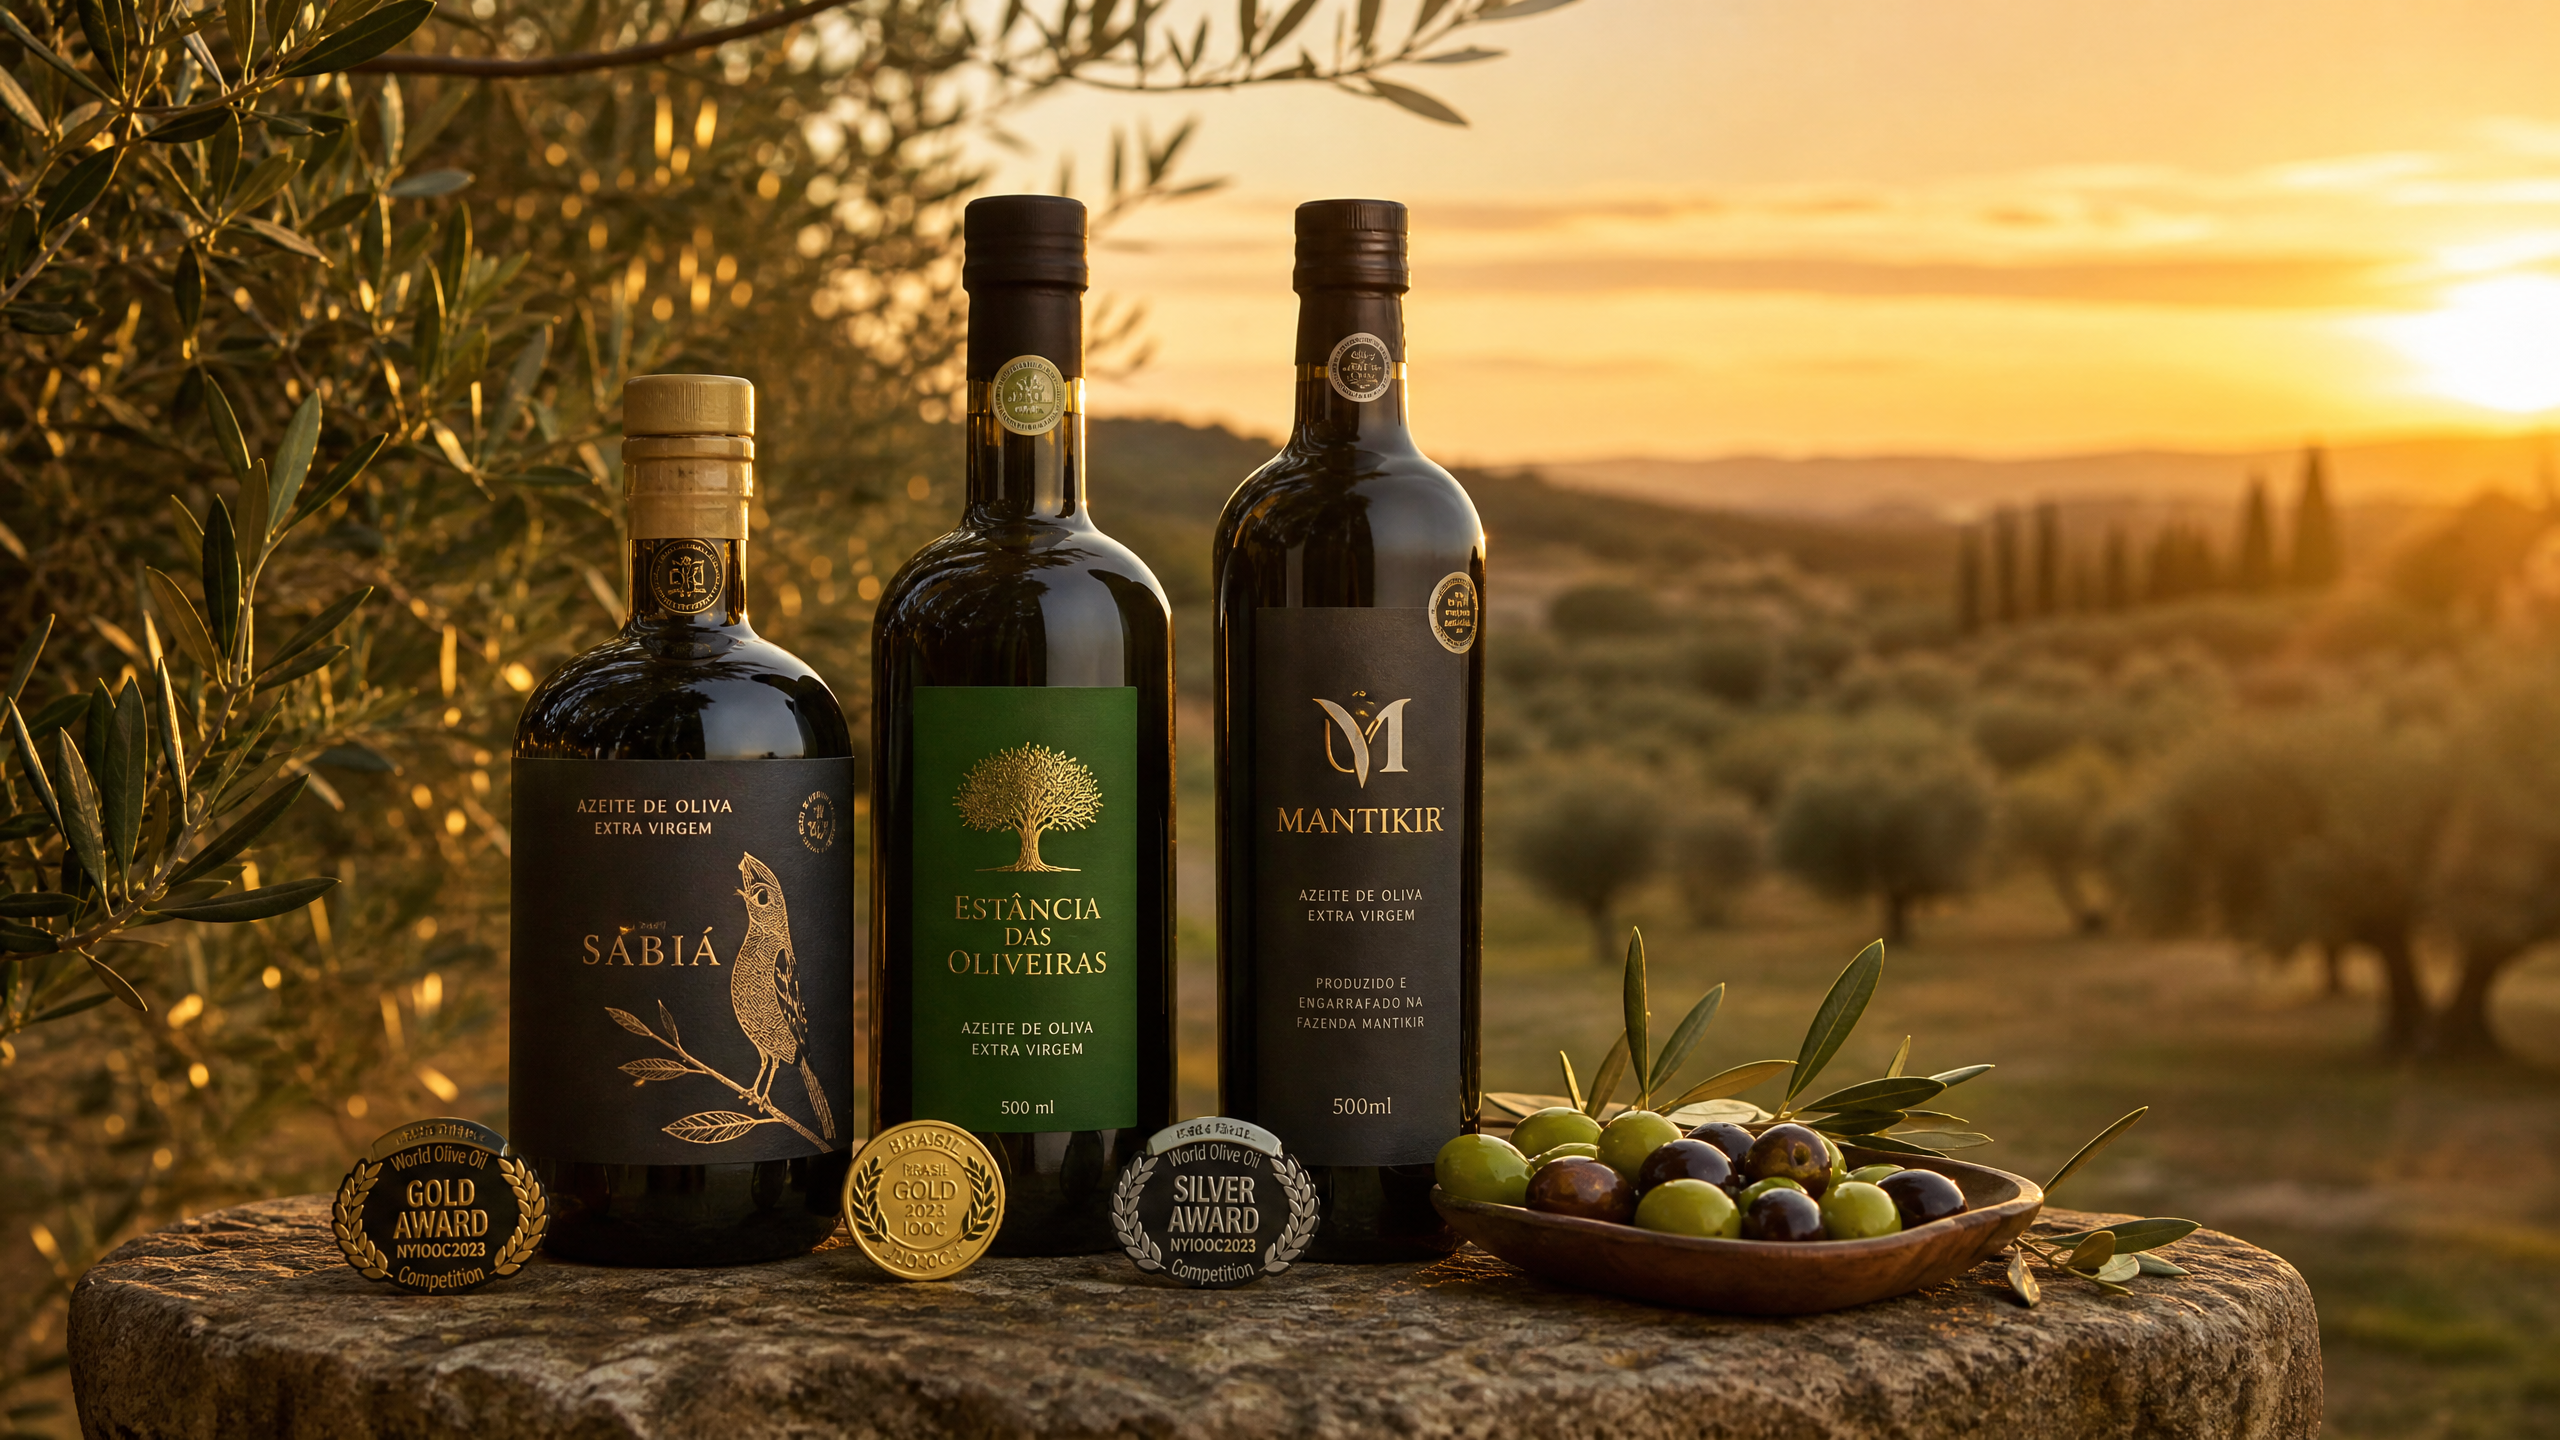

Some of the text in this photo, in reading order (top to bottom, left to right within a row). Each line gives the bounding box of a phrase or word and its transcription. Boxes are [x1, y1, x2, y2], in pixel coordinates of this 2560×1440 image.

[577, 799, 732, 813] AZEITE DE OLIVA
[595, 822, 711, 834] EXTRA VIRGEM
[1277, 807, 1444, 833] MANTIKIR
[1299, 889, 1422, 901] AZEITE DE OLIVA
[955, 893, 1101, 920] ESTÂNCIA
[1309, 909, 1414, 921] EXTRA VIRGEM
[1006, 928, 1050, 946] DAS
[948, 951, 1106, 975] OLIVEIRAS
[1317, 977, 1407, 989] PRODUZIDO E
[1300, 997, 1422, 1009] ENGARRAFADO NA
[962, 1021, 1093, 1035] AZEITE DE OLIVA
[1298, 1016, 1424, 1029] FAZENDA MANTIKIR
[973, 1043, 1082, 1056] EXTRA VIRGEM
[1001, 1100, 1053, 1114] 500 ml
[1333, 1097, 1391, 1114] 500ml
[390, 1145, 489, 1172] World Olive Oil
[1167, 1144, 1206, 1167] World
[1209, 1143, 1241, 1163] Olive
[407, 1179, 475, 1207] GOLD
[893, 1179, 959, 1201] GOLD
[1174, 1175, 1255, 1203] SILVER
[905, 1203, 947, 1218] 2023
[1168, 1206, 1259, 1233] AWARD
[394, 1210, 488, 1239] AWARD
[398, 1265, 485, 1293] Competition
[1171, 1258, 1255, 1285] Competition
